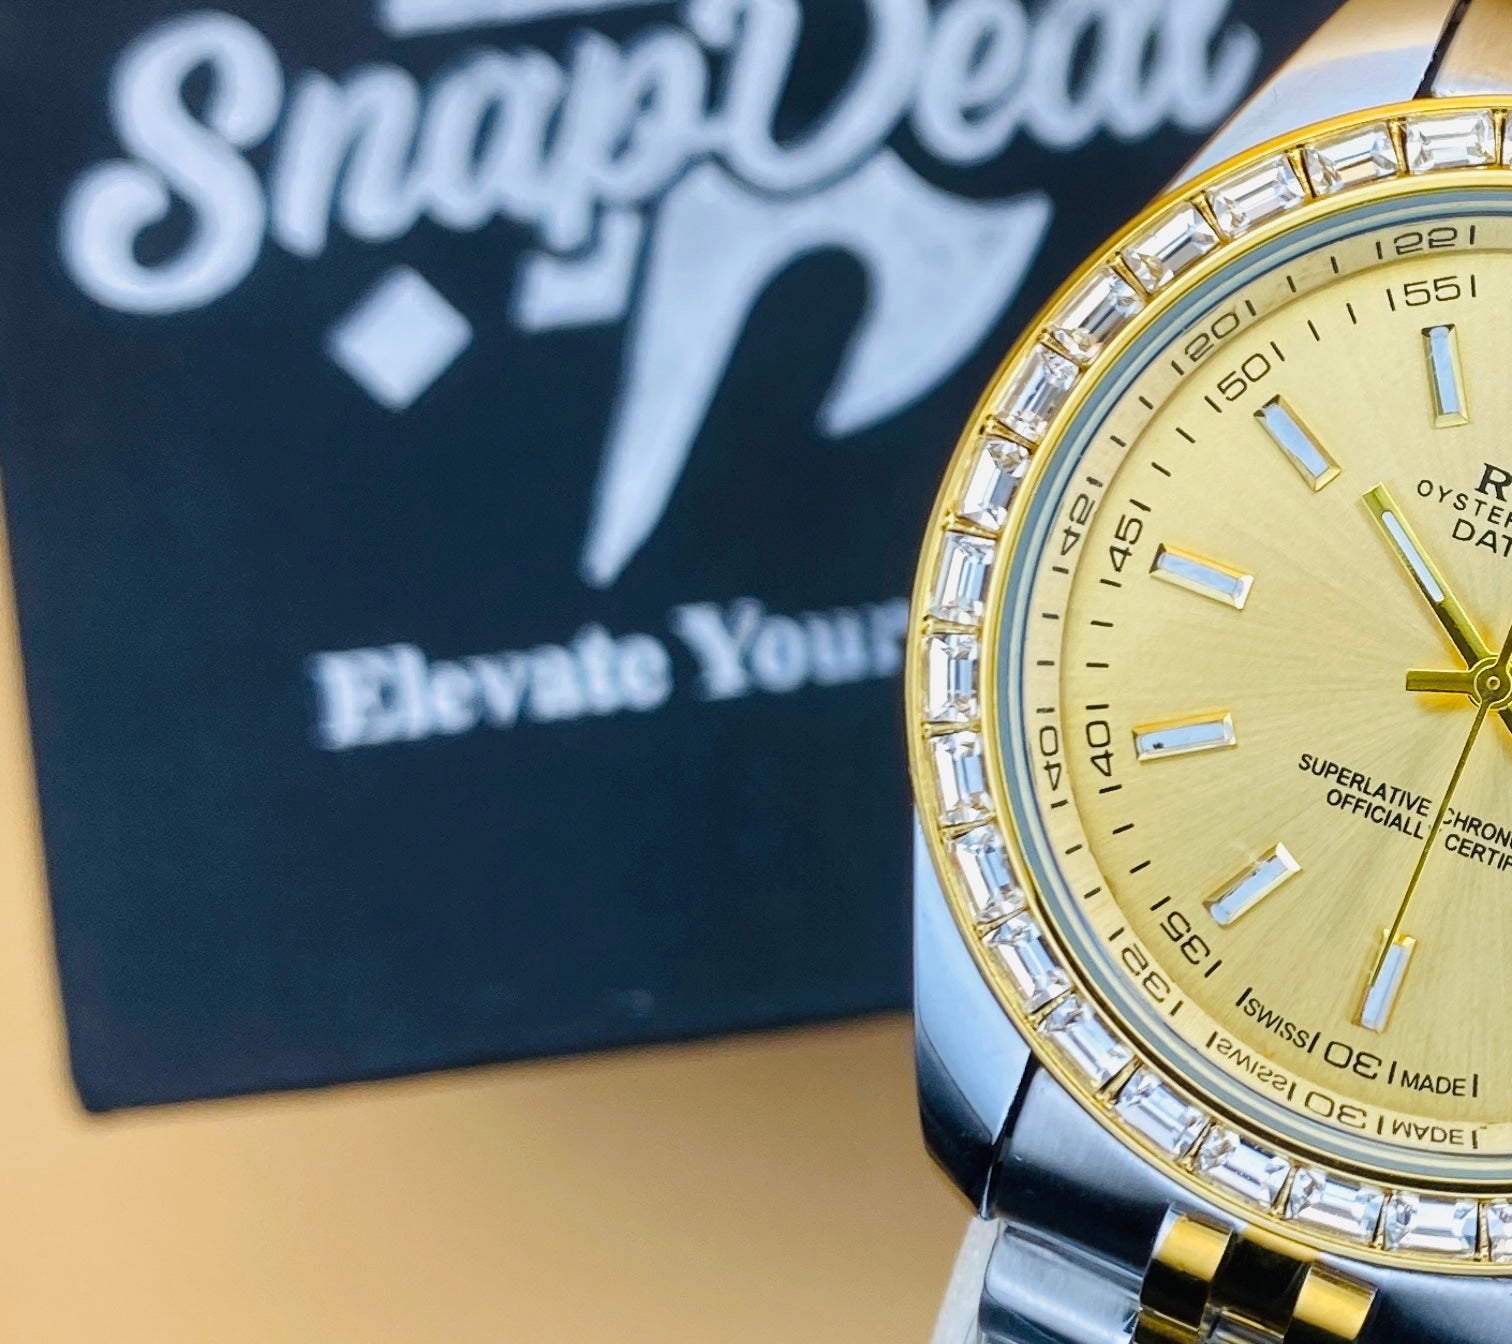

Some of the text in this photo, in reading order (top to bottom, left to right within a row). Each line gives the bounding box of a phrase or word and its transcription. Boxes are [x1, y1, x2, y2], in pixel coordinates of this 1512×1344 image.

[1403, 276, 1461, 306] 55
[1216, 353, 1271, 401] 50
[1109, 514, 1145, 573] 45
[317, 623, 673, 750] Elevate
[1086, 720, 1114, 777] 40
[1298, 753, 1432, 817] SUPERLATIVE
[1326, 788, 1442, 843] OFFICIALL
[1160, 910, 1211, 965] 35
[1244, 997, 1467, 1096] SWISS 30 MADE
